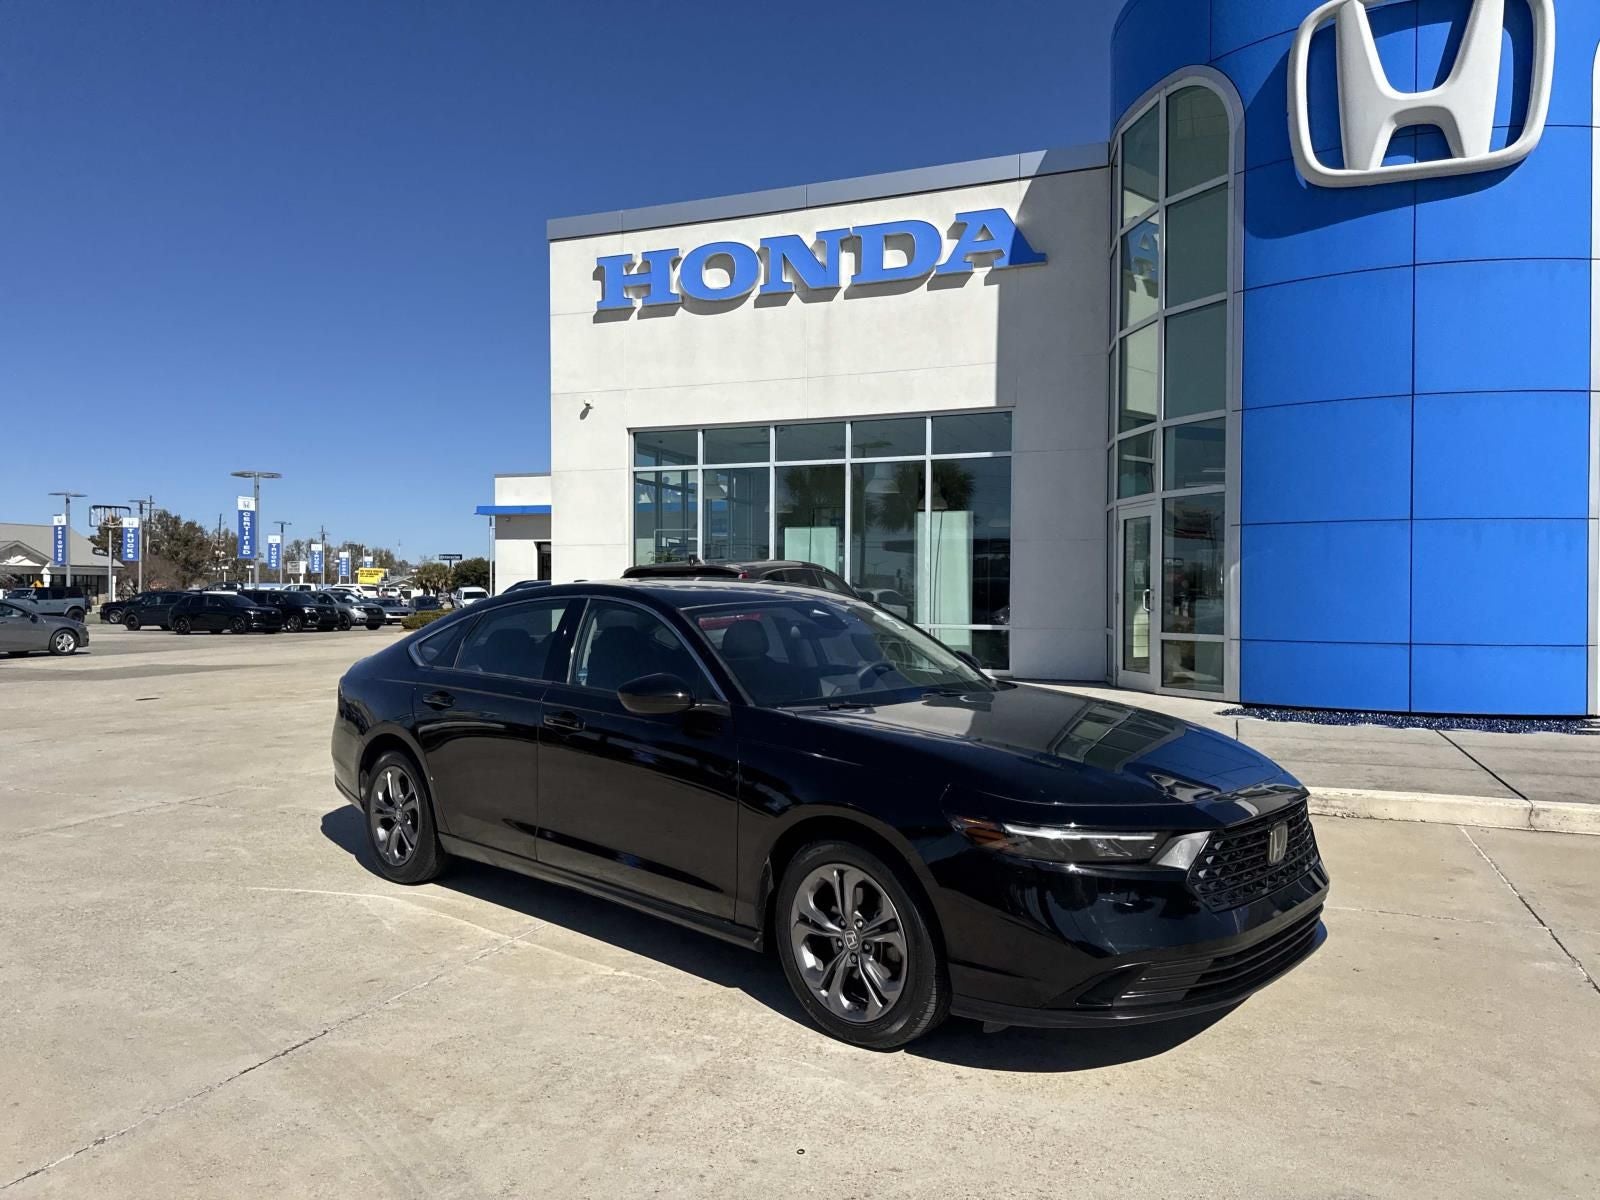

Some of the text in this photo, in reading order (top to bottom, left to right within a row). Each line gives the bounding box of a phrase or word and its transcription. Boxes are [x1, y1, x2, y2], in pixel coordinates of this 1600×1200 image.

[596, 207, 1047, 312] HONDA
[126, 529, 135, 559] TRUCKS
[243, 512, 251, 555] CERTIFIED
